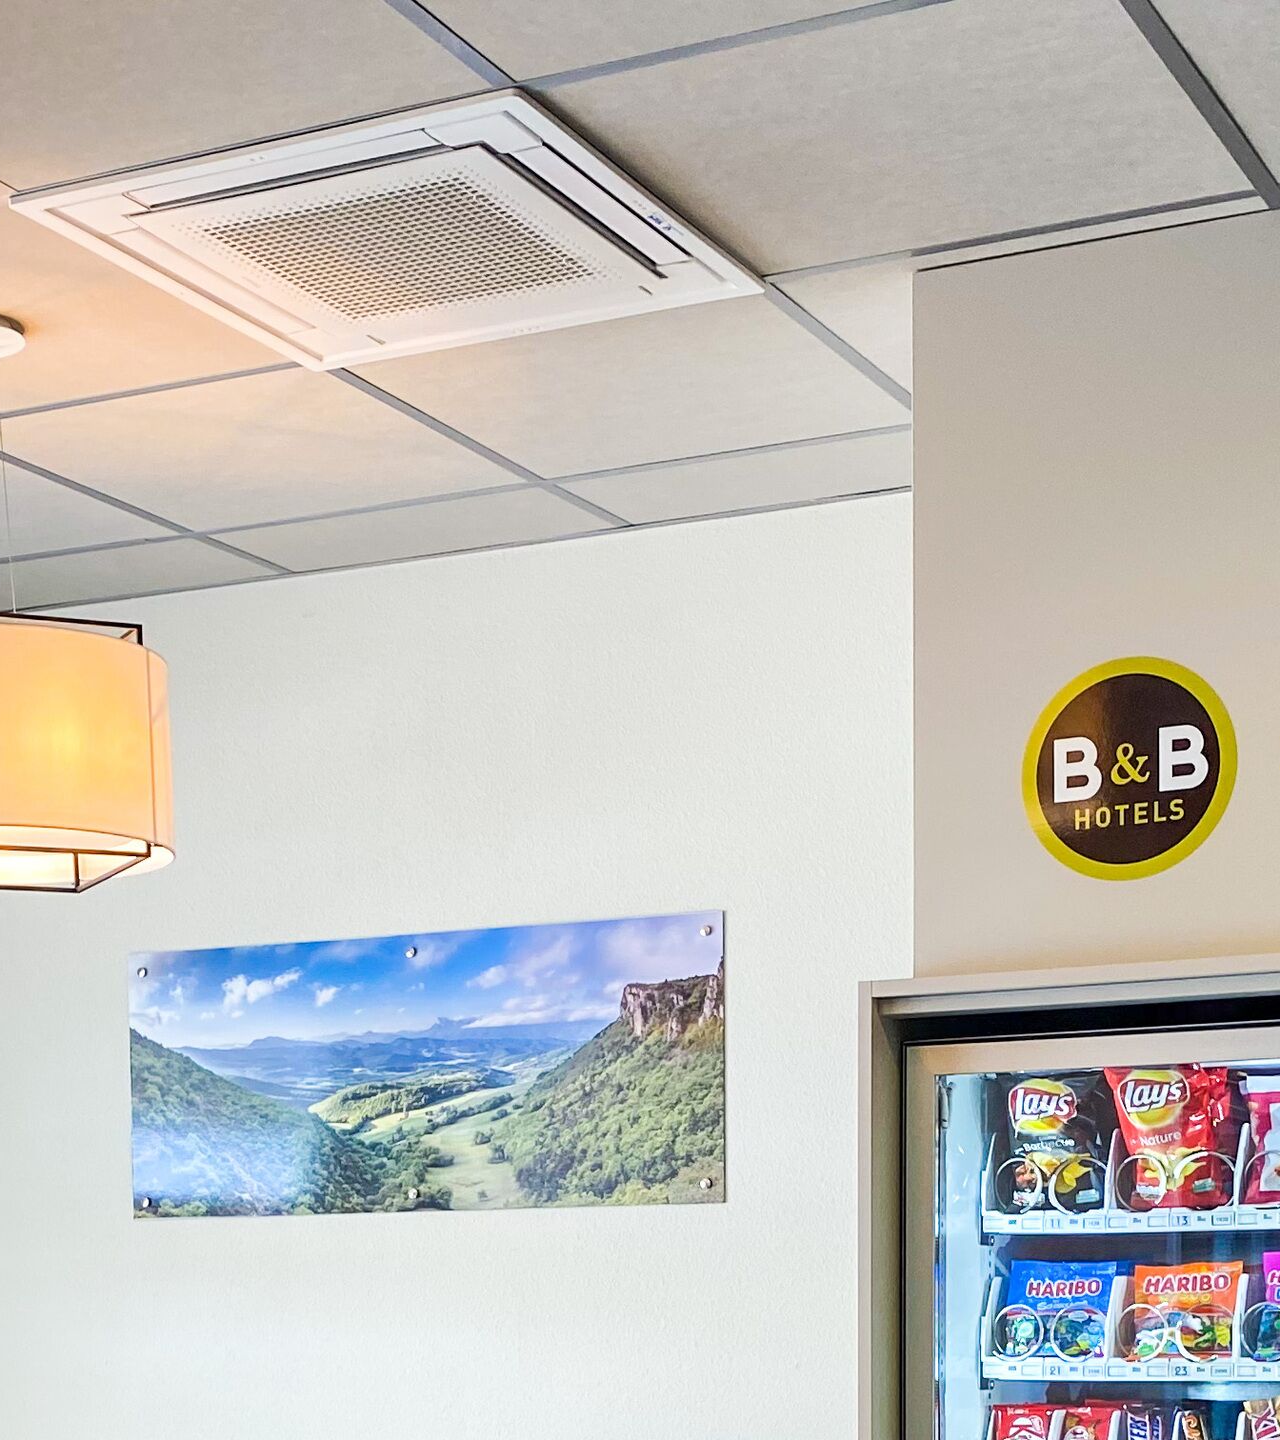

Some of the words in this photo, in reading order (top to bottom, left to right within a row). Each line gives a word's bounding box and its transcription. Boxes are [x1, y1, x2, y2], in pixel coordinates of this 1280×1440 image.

[1053, 723, 1210, 803] B&B
[1073, 798, 1186, 831] HOTELS
[1139, 1131, 1182, 1146] Nature
[1175, 1216, 1188, 1226] 13
[1027, 1278, 1102, 1298] HARIBO
[1144, 1273, 1231, 1294] HARIBO
[1049, 1366, 1061, 1375] 21
[1174, 1366, 1188, 1375] 23
